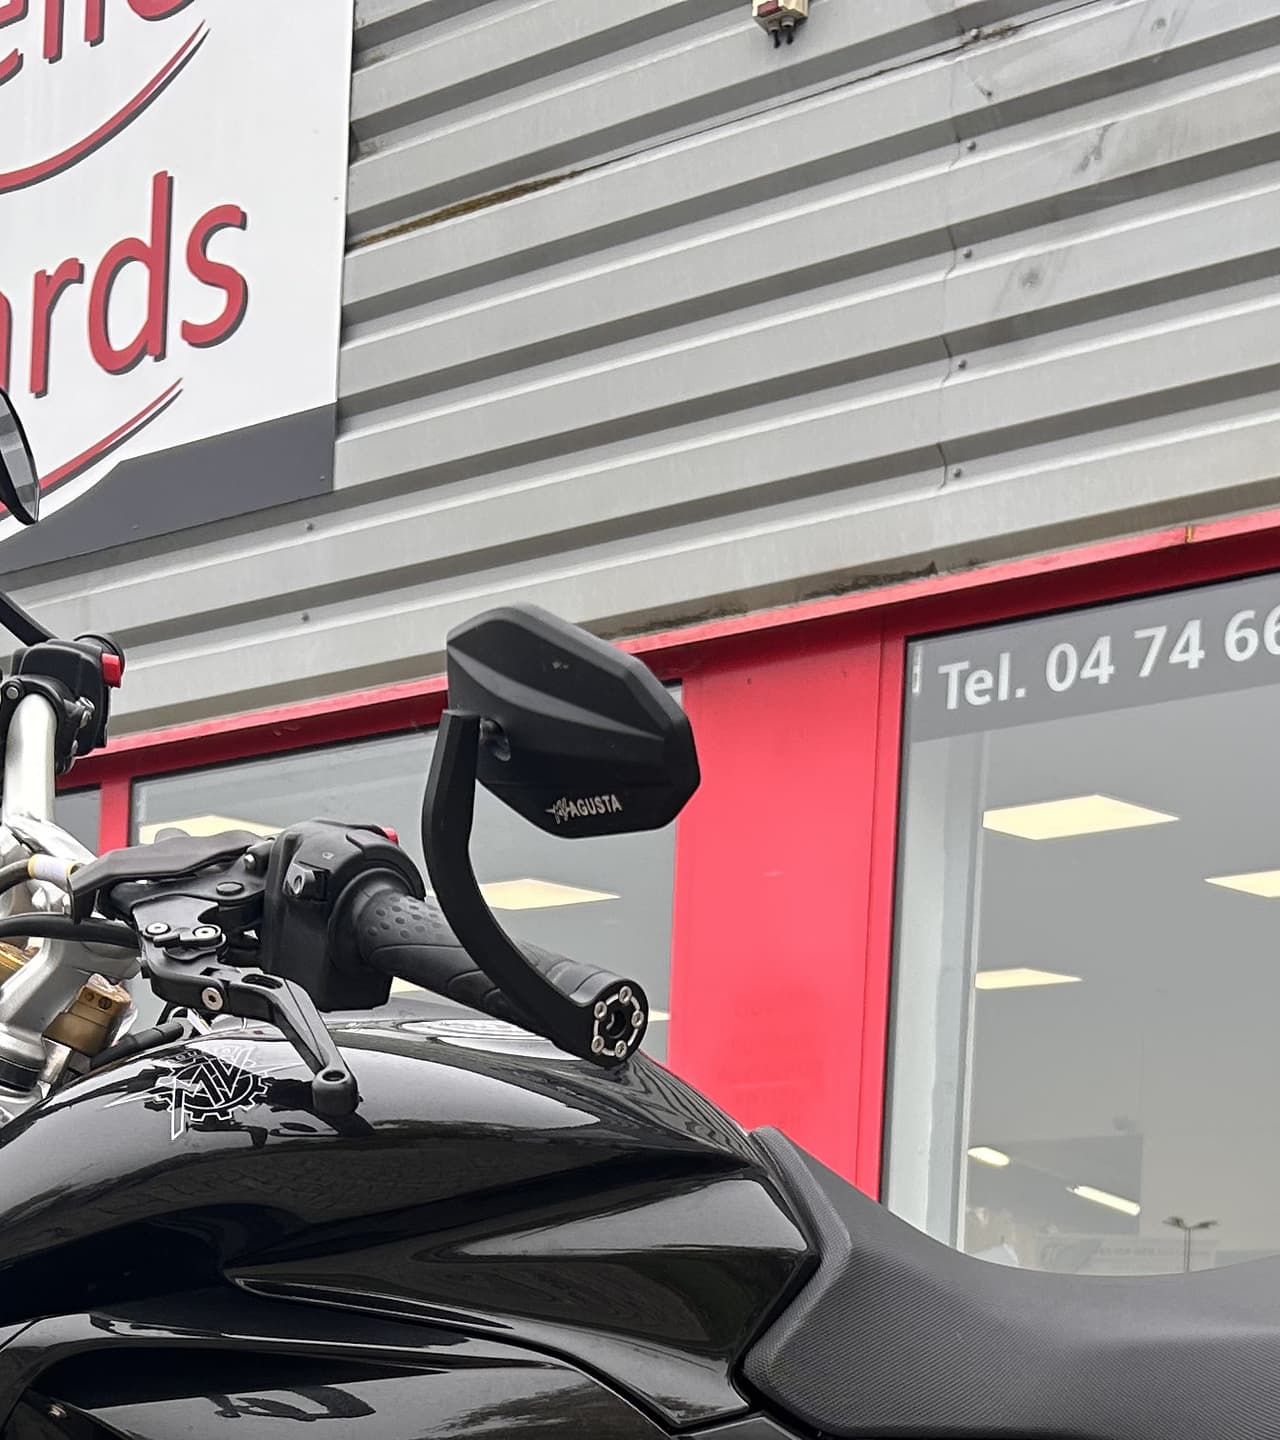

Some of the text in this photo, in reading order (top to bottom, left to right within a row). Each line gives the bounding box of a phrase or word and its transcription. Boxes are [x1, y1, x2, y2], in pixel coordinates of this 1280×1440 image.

[937, 652, 1027, 711] Tel.
[1044, 635, 1114, 692] 04
[1133, 618, 1205, 678] 74
[569, 793, 623, 819] AGUSTA
